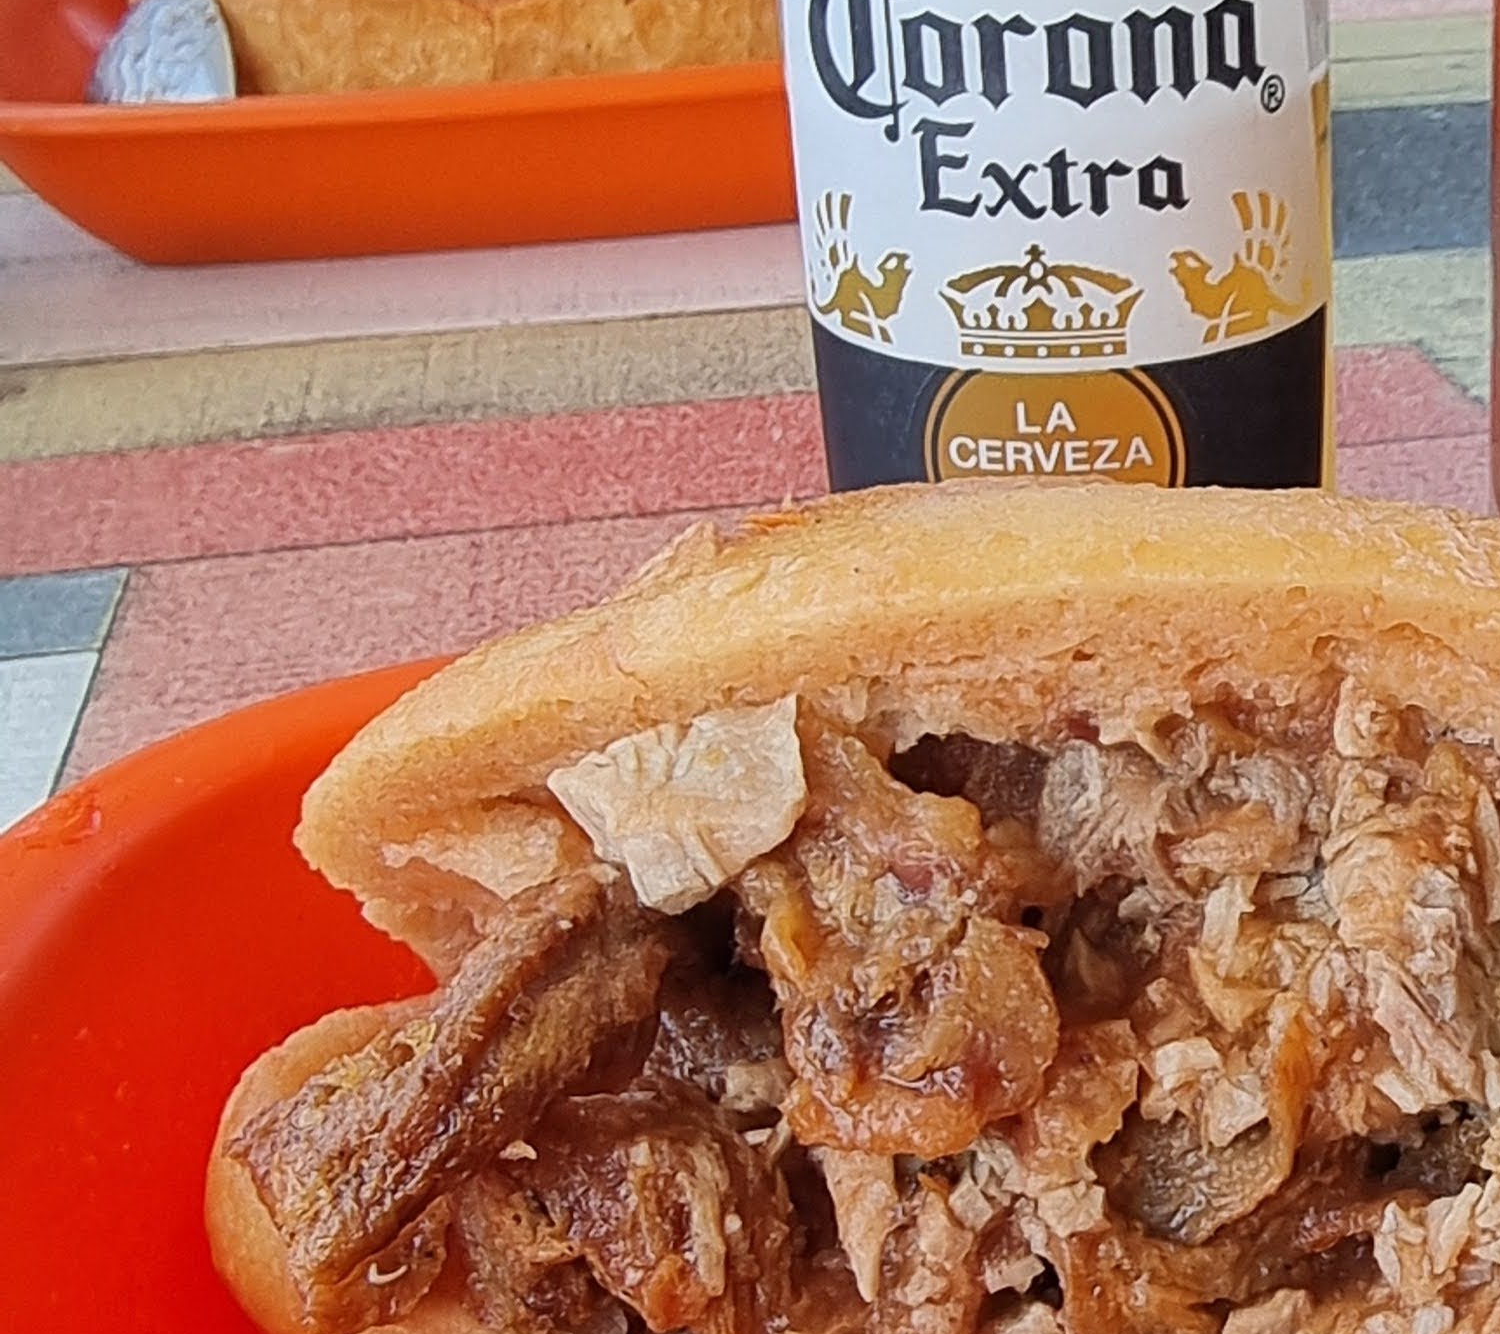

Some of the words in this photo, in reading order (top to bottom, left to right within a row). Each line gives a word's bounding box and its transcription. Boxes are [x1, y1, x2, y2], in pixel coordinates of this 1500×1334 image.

[911, 117, 1190, 220] Extra
[1015, 401, 1077, 435] LA
[948, 435, 1154, 474] CERVEZA
